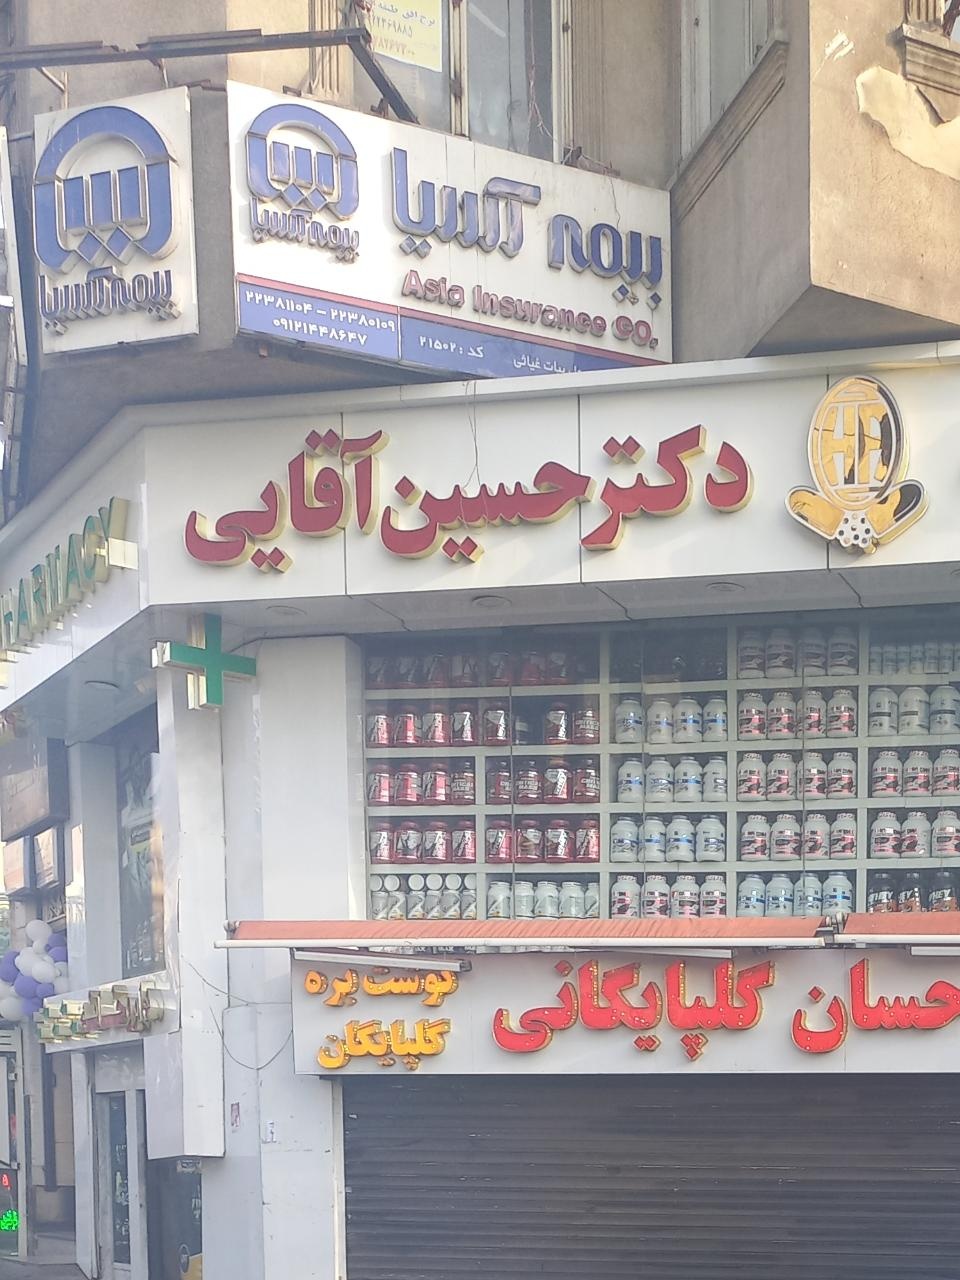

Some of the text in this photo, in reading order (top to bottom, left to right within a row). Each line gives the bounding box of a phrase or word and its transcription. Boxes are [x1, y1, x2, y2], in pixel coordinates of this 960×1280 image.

[390, 147, 663, 310] بیمه آسیا
[401, 269, 465, 307] Asia
[472, 284, 607, 337] Insurance
[419, 335, 457, 352] ۲۱۵۰۲
[184, 429, 389, 573] آقایی
[379, 460, 596, 563] حسین
[581, 424, 755, 551] دکتر
[304, 969, 359, 1007] بره
